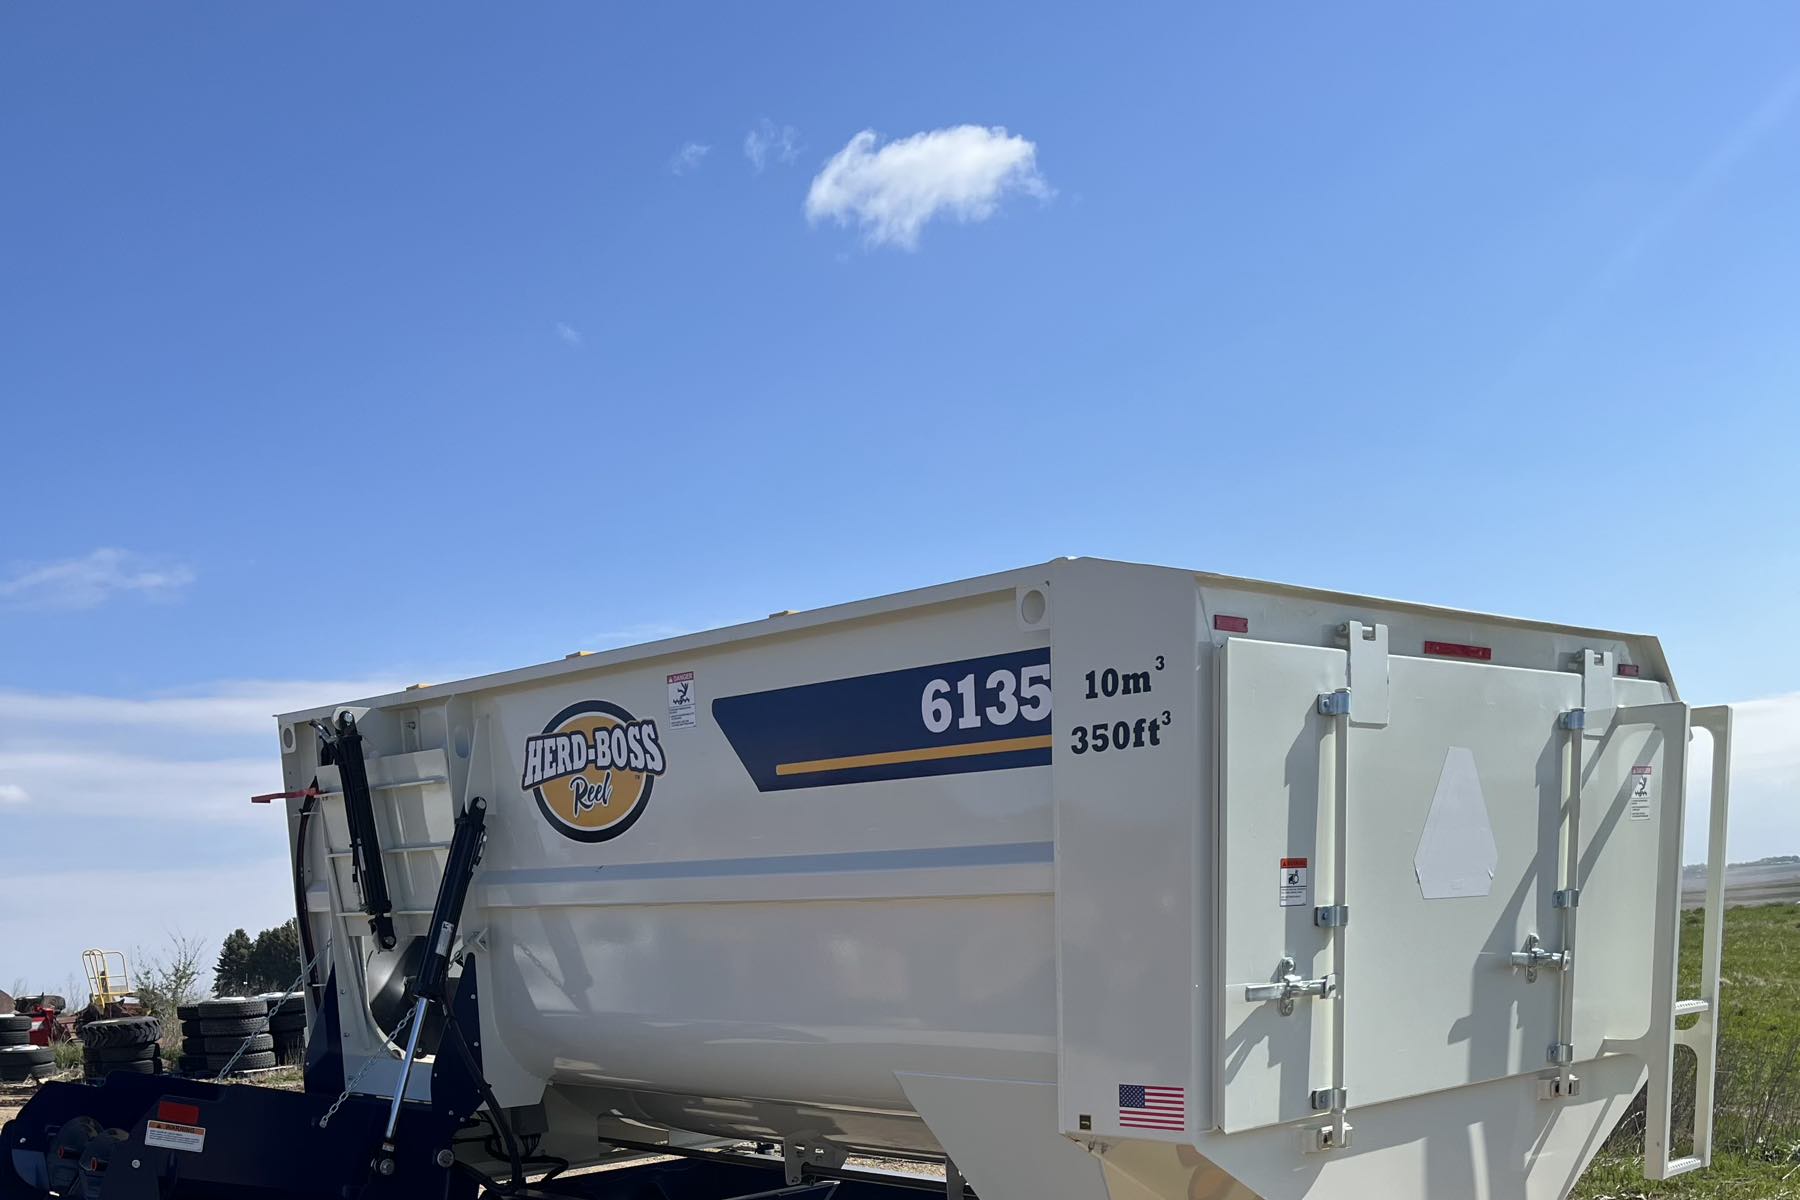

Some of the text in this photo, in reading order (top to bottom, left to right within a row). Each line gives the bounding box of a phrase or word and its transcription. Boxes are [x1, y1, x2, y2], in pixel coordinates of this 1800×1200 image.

[921, 663, 1051, 734] 6135
[523, 723, 665, 787] HERD-BOSS
[569, 770, 612, 818] Reel
